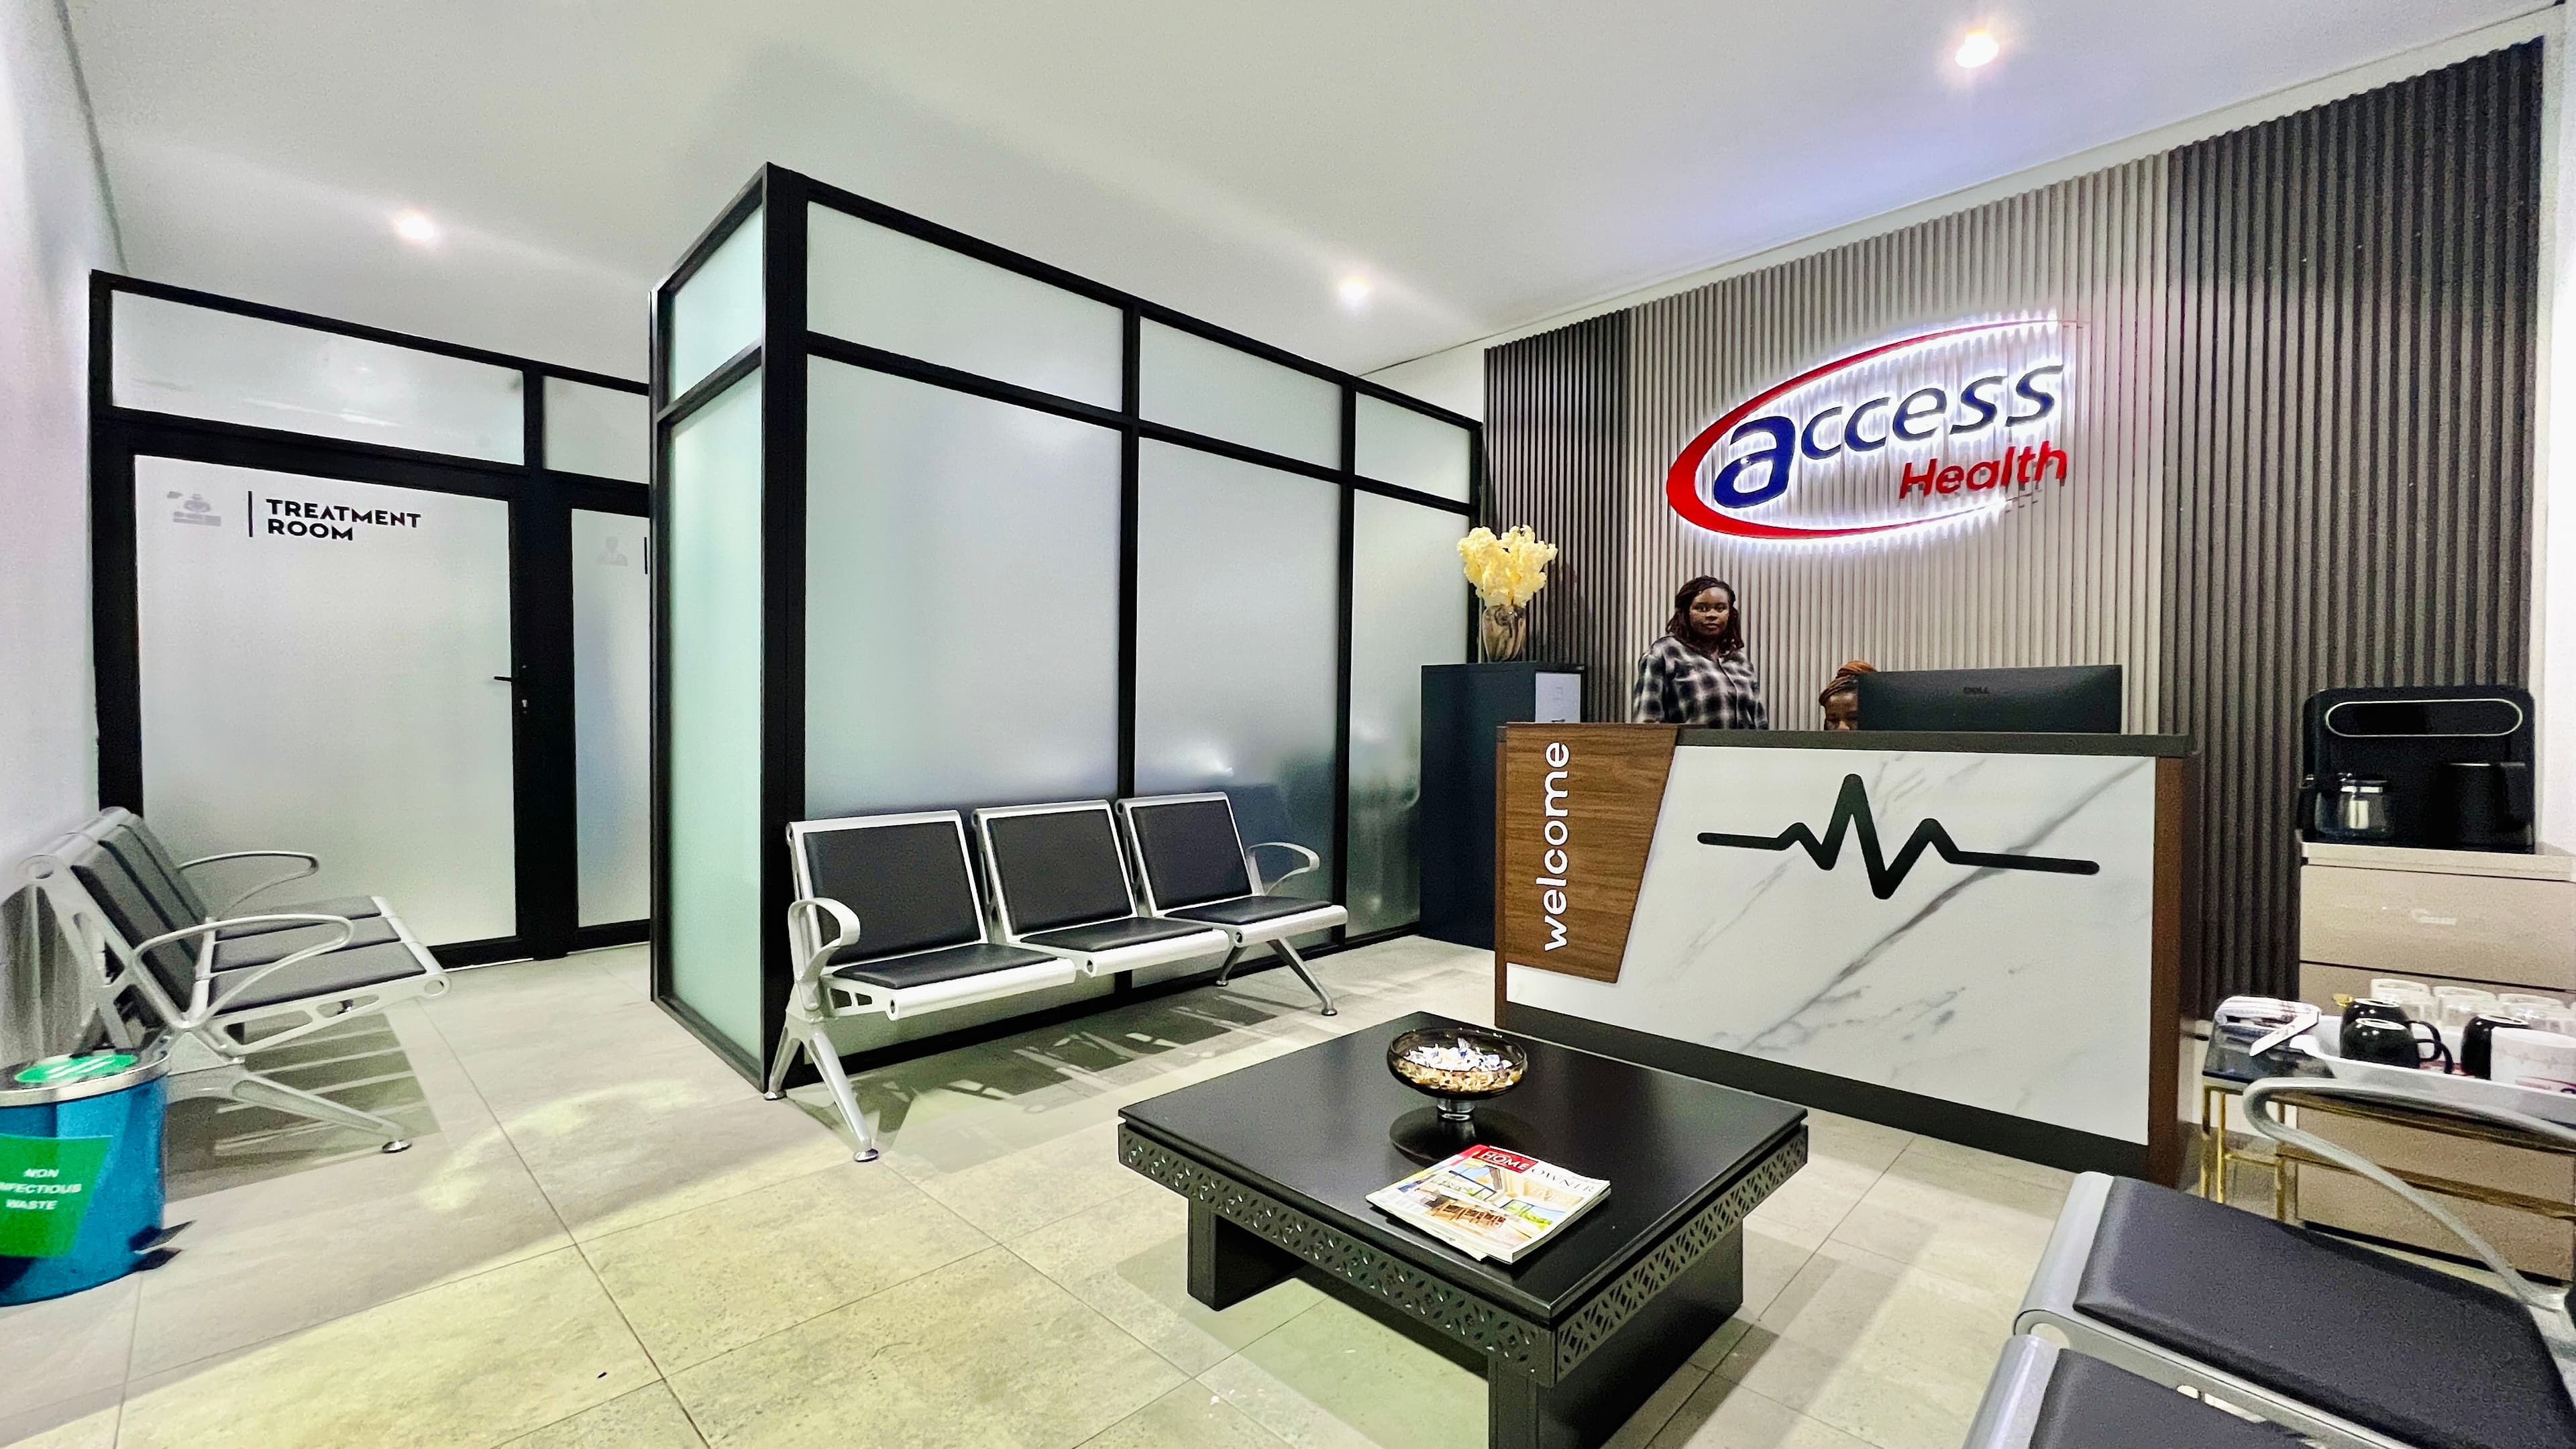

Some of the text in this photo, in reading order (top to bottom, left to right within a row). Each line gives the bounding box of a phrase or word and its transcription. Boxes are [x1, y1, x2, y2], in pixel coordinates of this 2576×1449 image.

[1713, 365, 2063, 508] access
[1898, 440, 2067, 500] Health
[266, 498, 421, 527] TREATMENT
[268, 519, 353, 541] ROOM
[1536, 742, 1570, 951] welcome
[23, 1169, 59, 1178] NON
[1481, 1150, 1595, 1192] HOME OWNER
[0, 1182, 82, 1193] NFECTIOUS
[6, 1199, 58, 1210] WASTE
